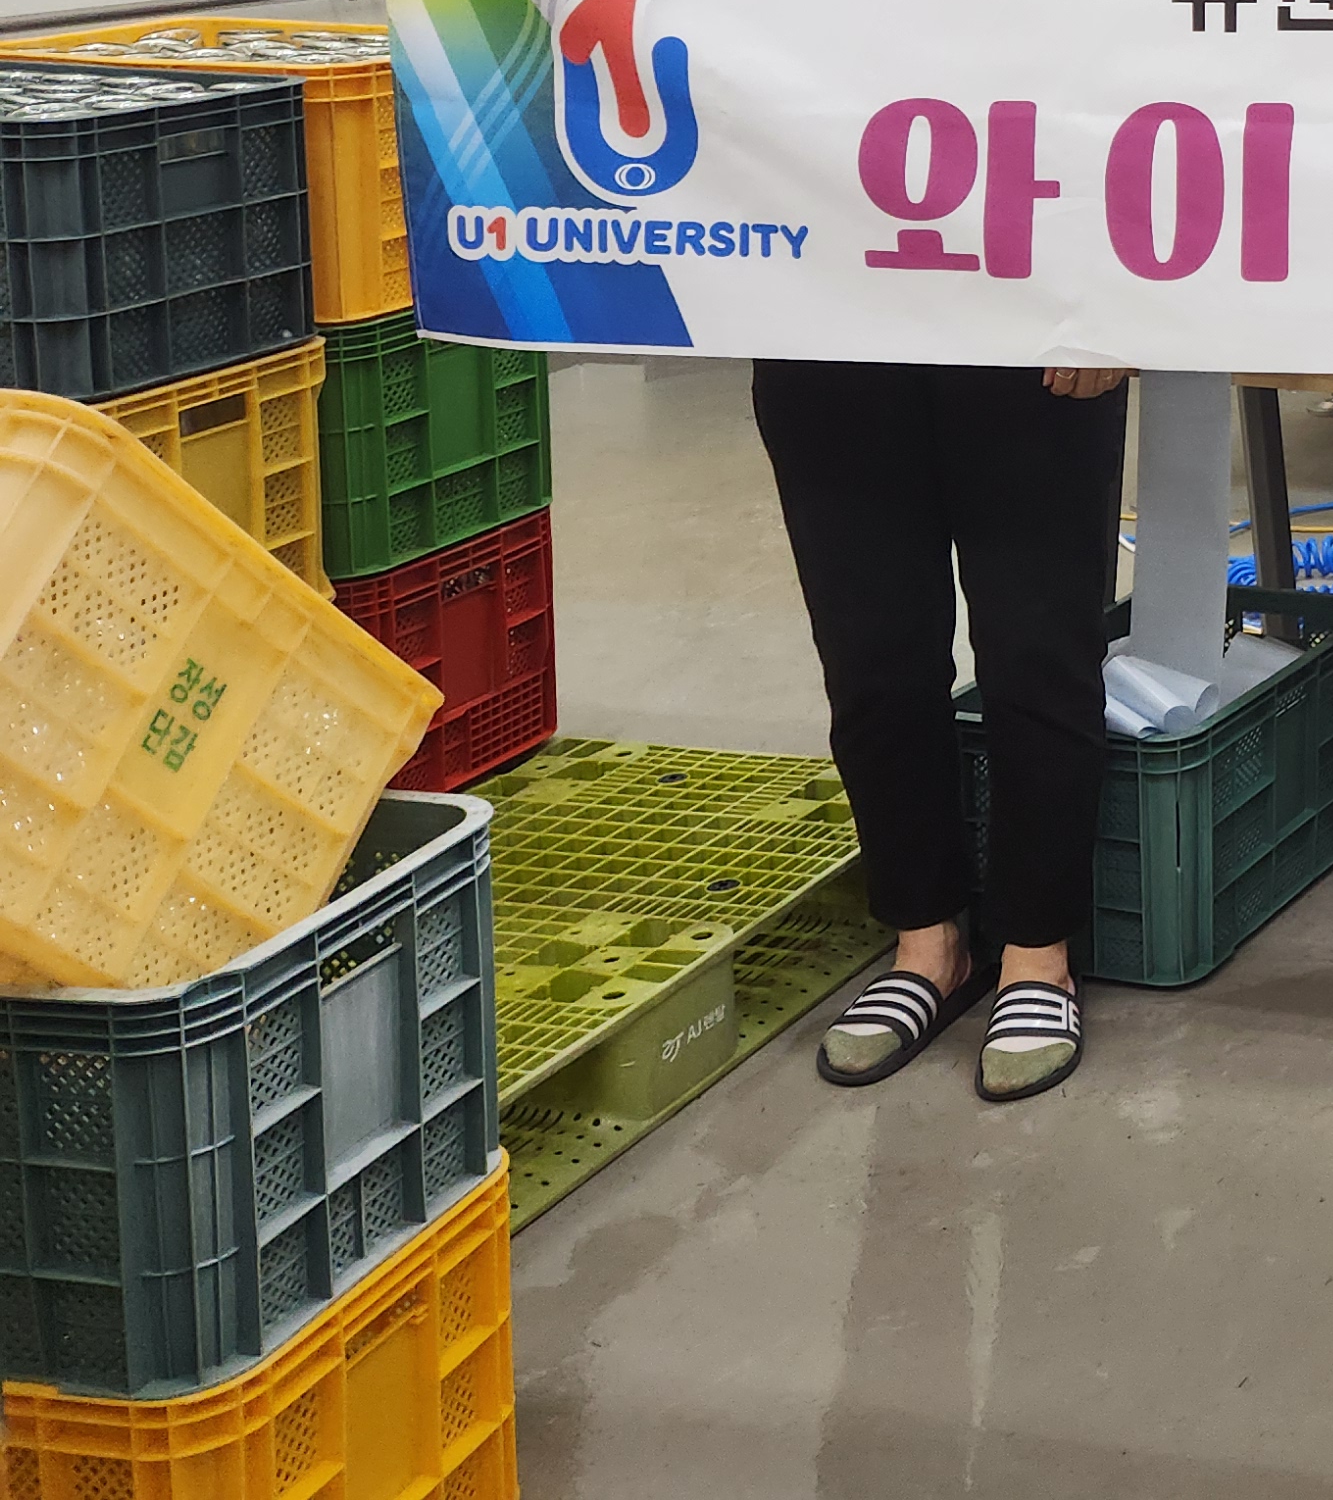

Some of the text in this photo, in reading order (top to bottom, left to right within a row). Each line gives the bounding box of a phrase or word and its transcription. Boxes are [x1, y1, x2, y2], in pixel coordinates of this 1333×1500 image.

[456, 215, 809, 259] U1 UNIVERSITY
[170, 657, 228, 721] 장성
[141, 707, 199, 773] 단감
